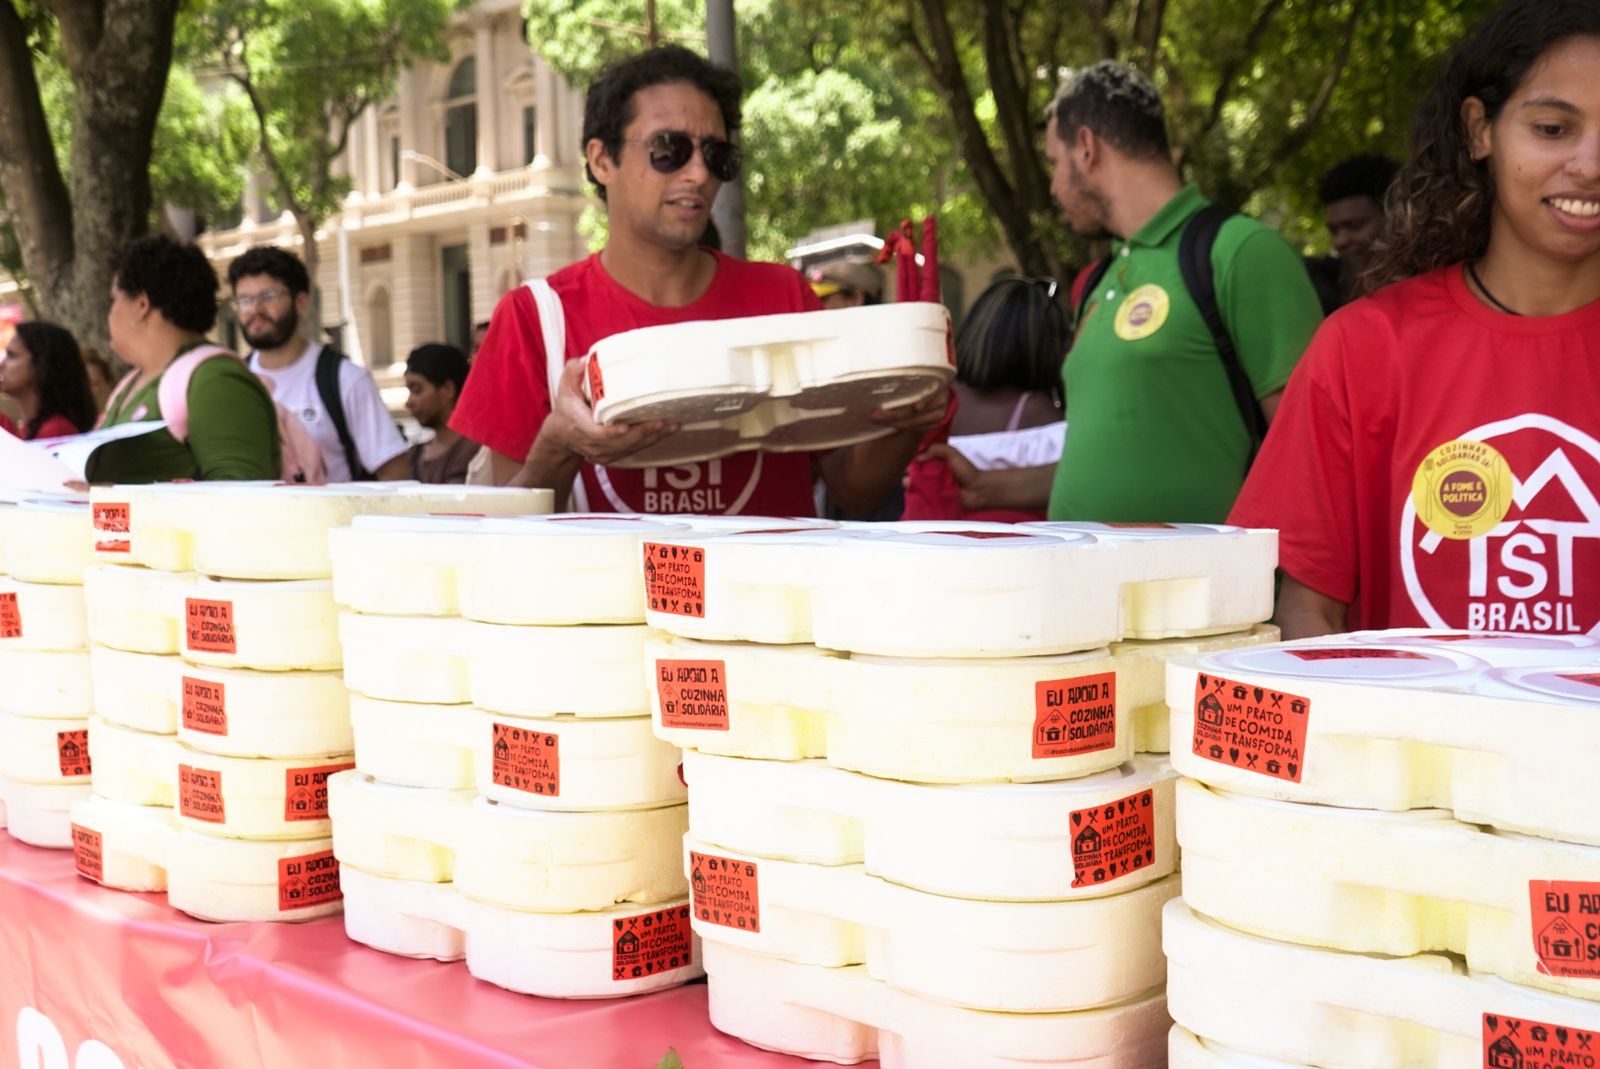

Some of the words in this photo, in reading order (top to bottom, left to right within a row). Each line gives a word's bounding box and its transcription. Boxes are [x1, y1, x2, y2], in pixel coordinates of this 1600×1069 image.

[1440, 443, 1488, 456] COZINHAS
[1443, 483, 1450, 493] A
[1451, 482, 1474, 493] FOME
[644, 489, 727, 513] BRASIL
[657, 562, 667, 570] UM
[668, 562, 690, 575] PRATO
[657, 573, 664, 582] DE
[665, 573, 698, 589] COMIDA
[657, 585, 702, 600] TRANSFORMA
[1468, 602, 1581, 631] BRASIL
[661, 667, 673, 682] EU
[711, 668, 719, 684] A
[680, 688, 726, 702] COZINHA
[1046, 688, 1063, 707] EU
[1101, 682, 1110, 699] A
[681, 702, 727, 716] SOLIDÁRIA
[1069, 703, 1114, 724] COZINHA
[1227, 703, 1242, 714] UM
[1246, 706, 1283, 725] PRATO
[1069, 720, 1114, 741] SOLIDÁRIA
[1225, 716, 1237, 728] DE
[1238, 719, 1293, 745] COMIDA
[1224, 731, 1299, 761] TRANSFORMA
[294, 773, 308, 786] EU
[1102, 823, 1114, 835] UM
[1116, 813, 1139, 832] PRATO
[1103, 836, 1112, 848] DE
[1112, 823, 1147, 847] COMIDA
[1104, 835, 1153, 862] TRANSFORMA
[287, 862, 301, 876] EU
[719, 874, 742, 888] PRATO
[715, 885, 751, 902] COMIDA
[1545, 892, 1569, 913] EU
[708, 896, 756, 914] TRANSFORMA
[1525, 1045, 1544, 1058] UM
[1550, 1048, 1595, 1068] PRATO
